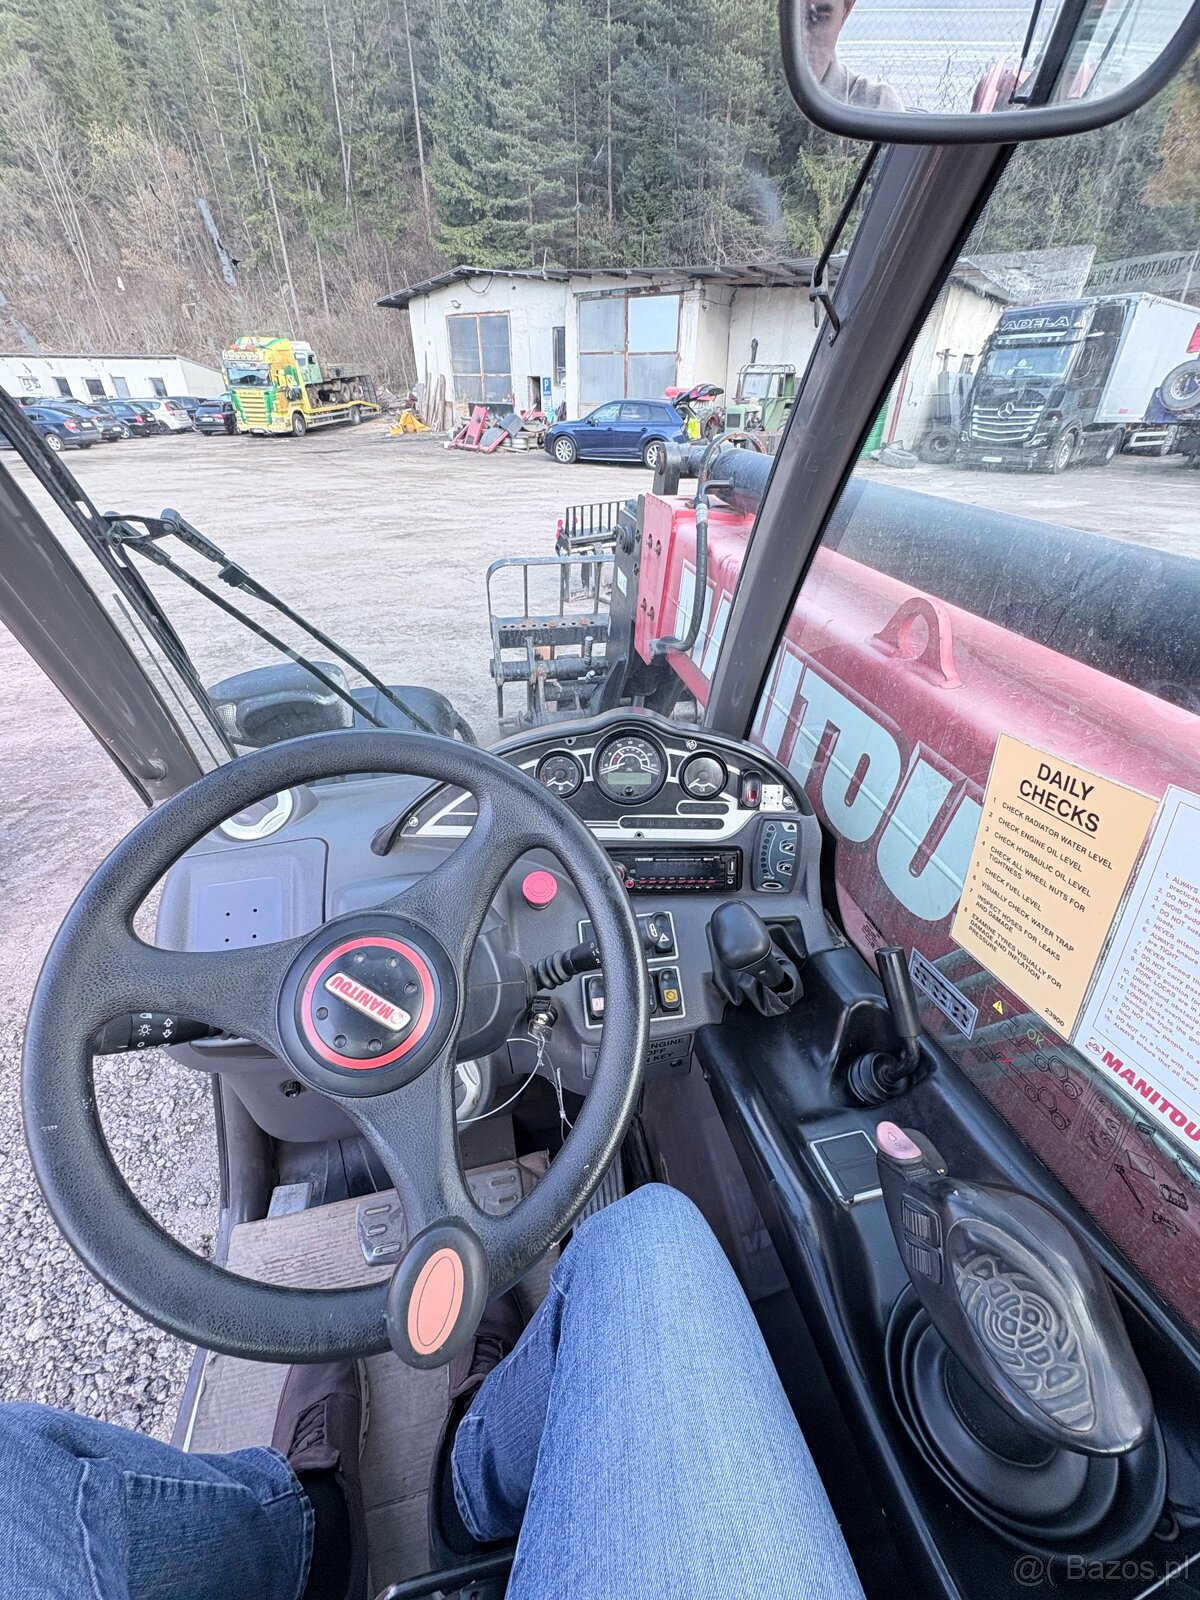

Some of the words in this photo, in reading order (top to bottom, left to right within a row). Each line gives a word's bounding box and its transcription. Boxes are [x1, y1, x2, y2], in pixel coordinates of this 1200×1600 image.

[1036, 762, 1095, 801] DAILY
[1019, 779, 1100, 832] CHECKS
[997, 816, 1020, 834] CHECK
[1019, 829, 1046, 850] ENGINE
[1046, 846, 1058, 858] OIL
[1059, 853, 1083, 873] LEVEL
[1001, 801, 1024, 819] CHECK
[1024, 814, 1060, 839] RADIATOR
[1060, 834, 1087, 855] WATER
[1087, 850, 1113, 870] LEVEL
[984, 825, 990, 833] 3
[994, 831, 1016, 849] CHECK
[1015, 845, 1054, 873] HYDRAULIC
[1054, 869, 1067, 882] OIL
[1067, 877, 1091, 898] LEVEL
[989, 852, 1022, 880] TIGHTNESS
[990, 845, 1012, 864] CHECK
[1011, 860, 1023, 872] ALL
[1024, 867, 1047, 888] WHEEL
[1048, 884, 1069, 901] NUTS
[1068, 897, 1086, 913] FOR
[984, 867, 1006, 886] CHECK
[1005, 881, 1021, 897] FUEL
[1021, 893, 1042, 912] LEVEL
[1165, 891, 1177, 901] DO
[1177, 898, 1193, 910] NOT
[1171, 876, 1197, 894] ALWAYS
[975, 901, 988, 913] AND
[987, 910, 1013, 934] DAMAGE
[981, 880, 1008, 903] VISUALLY
[1007, 900, 1030, 921] CHECK
[1030, 916, 1054, 939] WATER
[1055, 934, 1075, 952] TRAP
[1156, 915, 1175, 930] loads.
[1158, 908, 1170, 918] DO
[1170, 915, 1186, 927] NOT
[1162, 900, 1183, 915] AVOID
[968, 925, 998, 953] PRESSURE
[976, 893, 1002, 915] INSPECT
[1001, 912, 1023, 932] HOSES
[1023, 929, 1038, 944] FOR
[1037, 940, 1061, 961] LEAKS
[1152, 923, 1175, 940] NEVER
[969, 919, 993, 942] DAMAGE
[993, 939, 1007, 952] AND
[1007, 950, 1041, 981] INFLATION
[971, 912, 997, 936] EXAMINE
[997, 932, 1016, 952] TYRES
[1016, 949, 1047, 976] VISUALLY
[1046, 974, 1062, 990] FOR
[1143, 945, 1165, 963] NEVER
[1166, 961, 1191, 979] exceed
[1147, 938, 1158, 948] are
[1159, 945, 1179, 962] TIGHT.
[1149, 931, 1175, 950] ALWAYS
[1176, 948, 1198, 964] ensure
[1138, 961, 1162, 980] ALWAYS
[1162, 978, 1189, 999] position
[1140, 953, 1151, 963] DO
[1151, 960, 1166, 972] NOT
[1166, 971, 1184, 985] carry
[330, 975, 395, 1020] MANITOU
[1123, 994, 1144, 1013] leaving
[1145, 1011, 1155, 1021] the
[1129, 981, 1155, 1003] BEWARE
[1163, 1007, 1194, 1031] overhead
[1132, 974, 1150, 990] DRIVE
[1150, 988, 1170, 1004] round
[1135, 966, 1152, 982] FORK
[1153, 979, 1177, 998] LOCKS
[1177, 997, 1189, 1007] are
[1190, 1005, 1197, 1013] in
[1044, 1007, 1065, 1027] 23900
[1120, 1001, 1131, 1011] DO
[1131, 1009, 1144, 1021] NOT
[1161, 1034, 1185, 1053] people
[1186, 1051, 1194, 1060] to
[1126, 988, 1148, 1007] LOWER
[1148, 1005, 1165, 1020] forks
[1166, 1018, 1174, 1027] to
[1175, 1025, 1187, 1036] the
[653, 1052, 674, 1061] KEY
[1026, 1028, 1045, 1048] OK
[1112, 1022, 1135, 1041] ALWAYS
[1136, 1040, 1156, 1058] ensure
[1157, 1056, 1171, 1070] that
[1181, 1076, 1197, 1091] daily
[1115, 1014, 1125, 1024] DO
[1125, 1022, 1139, 1034] NOT
[1185, 1070, 1197, 1081] one
[1104, 1053, 1200, 1141] MANITOU
